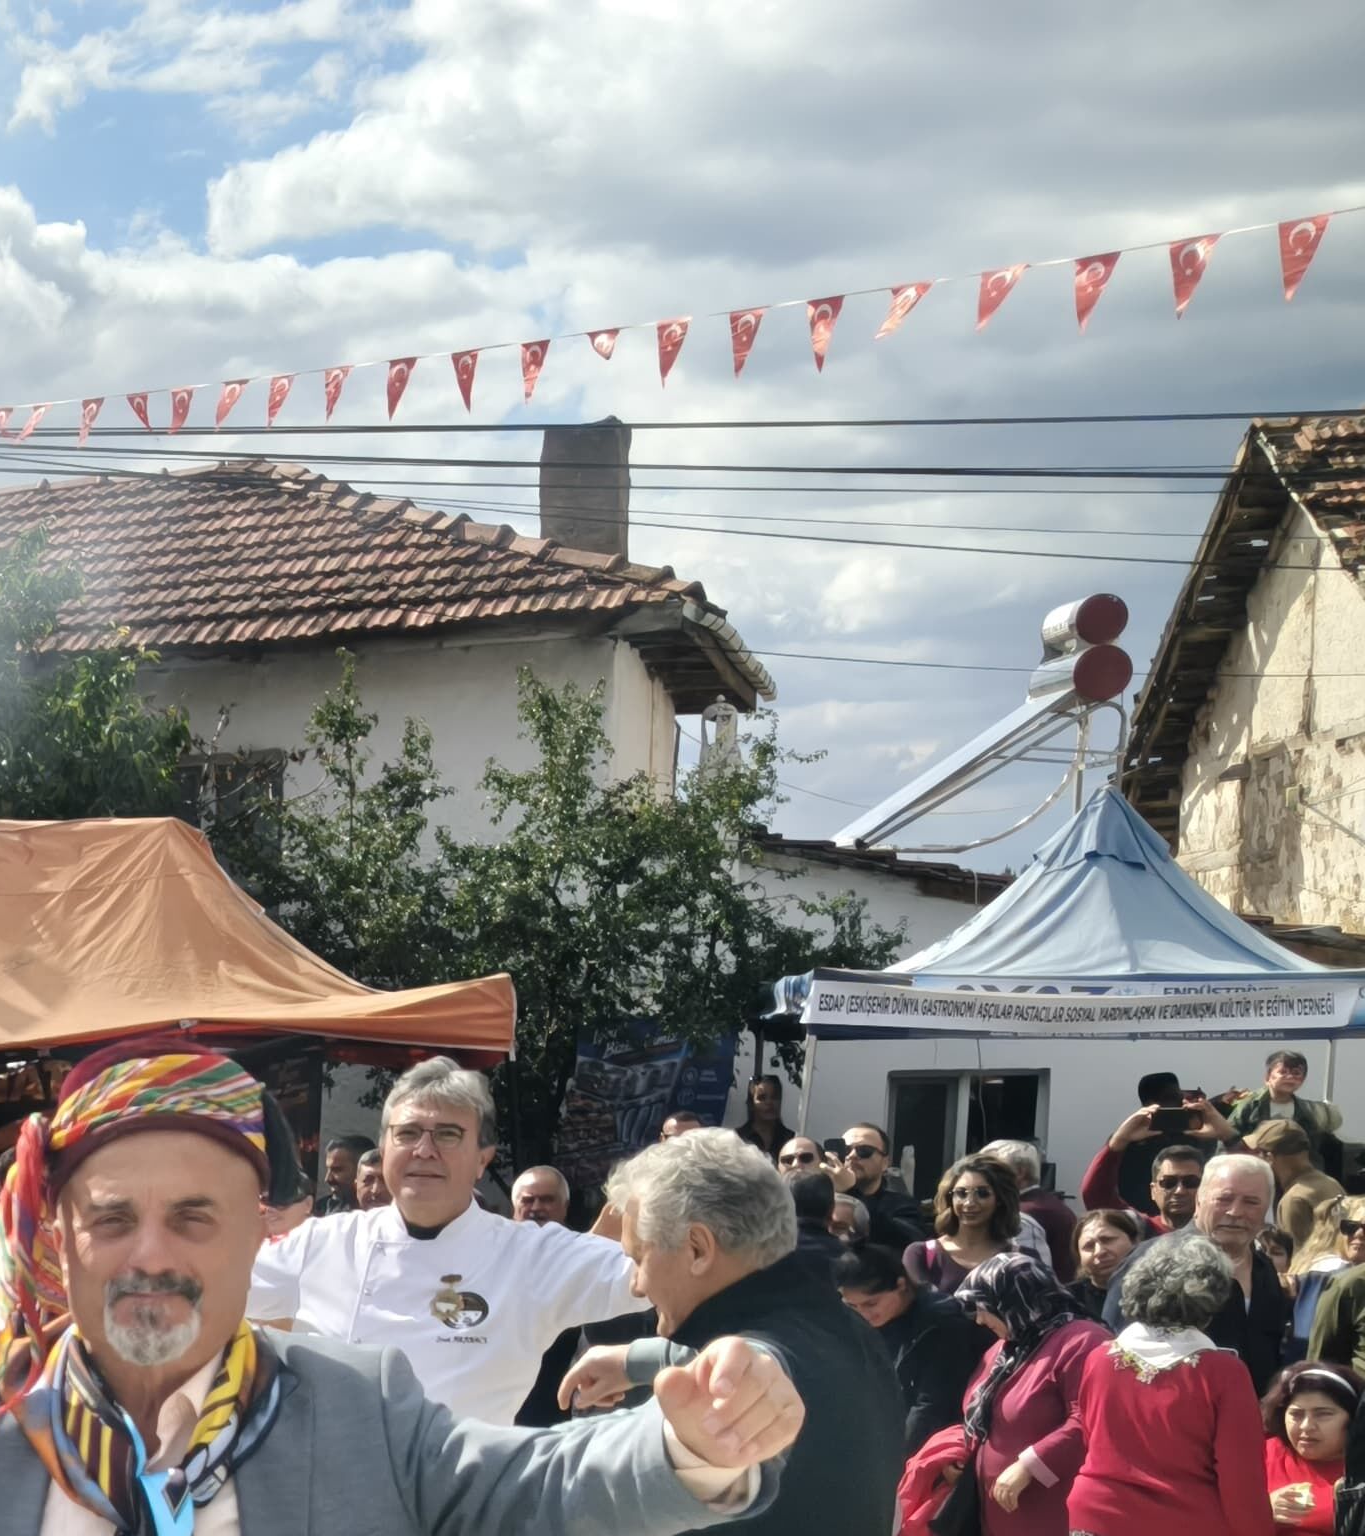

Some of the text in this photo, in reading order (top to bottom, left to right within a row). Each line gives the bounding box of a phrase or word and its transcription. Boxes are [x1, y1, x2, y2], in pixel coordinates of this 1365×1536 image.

[818, 993, 845, 1012] ESDAP
[846, 992, 890, 1017] (ESKİŞEHİR
[891, 992, 919, 1016] DÜNYA
[920, 998, 978, 1018] GASTRONOMİ
[1266, 995, 1295, 1017] EĞİTİM
[1297, 992, 1335, 1016] DERNEĞİ
